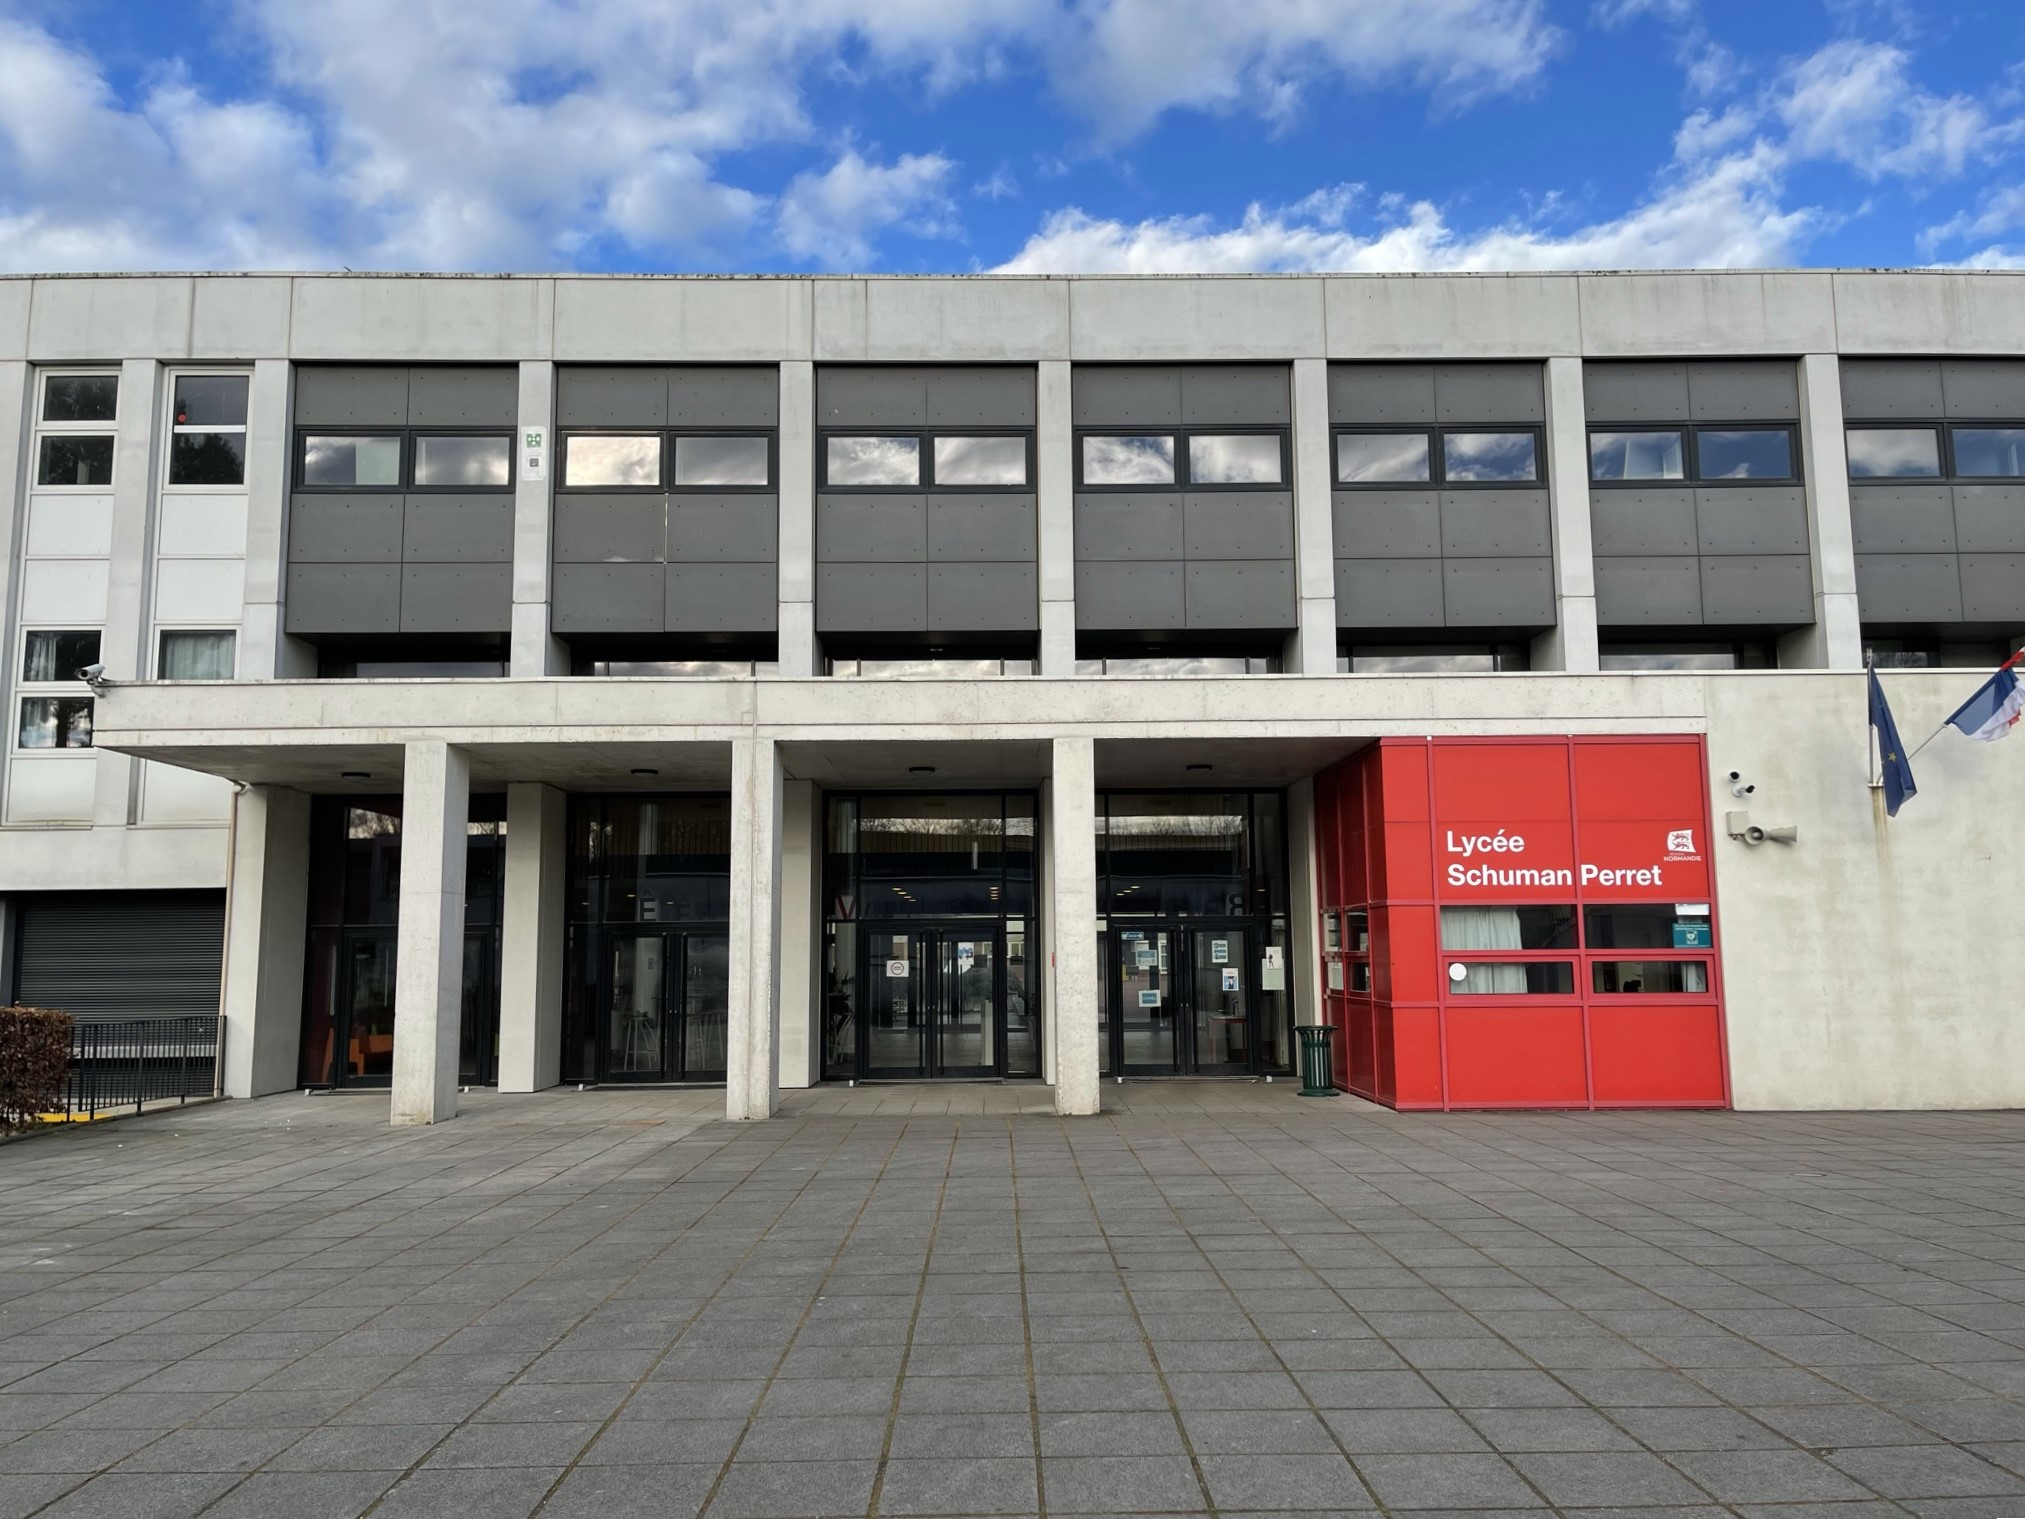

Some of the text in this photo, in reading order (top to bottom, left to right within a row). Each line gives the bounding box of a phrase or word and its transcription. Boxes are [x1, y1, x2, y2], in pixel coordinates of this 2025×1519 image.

[1447, 829, 1525, 857] Lycée
[1447, 864, 1663, 887] Schuman Perret
